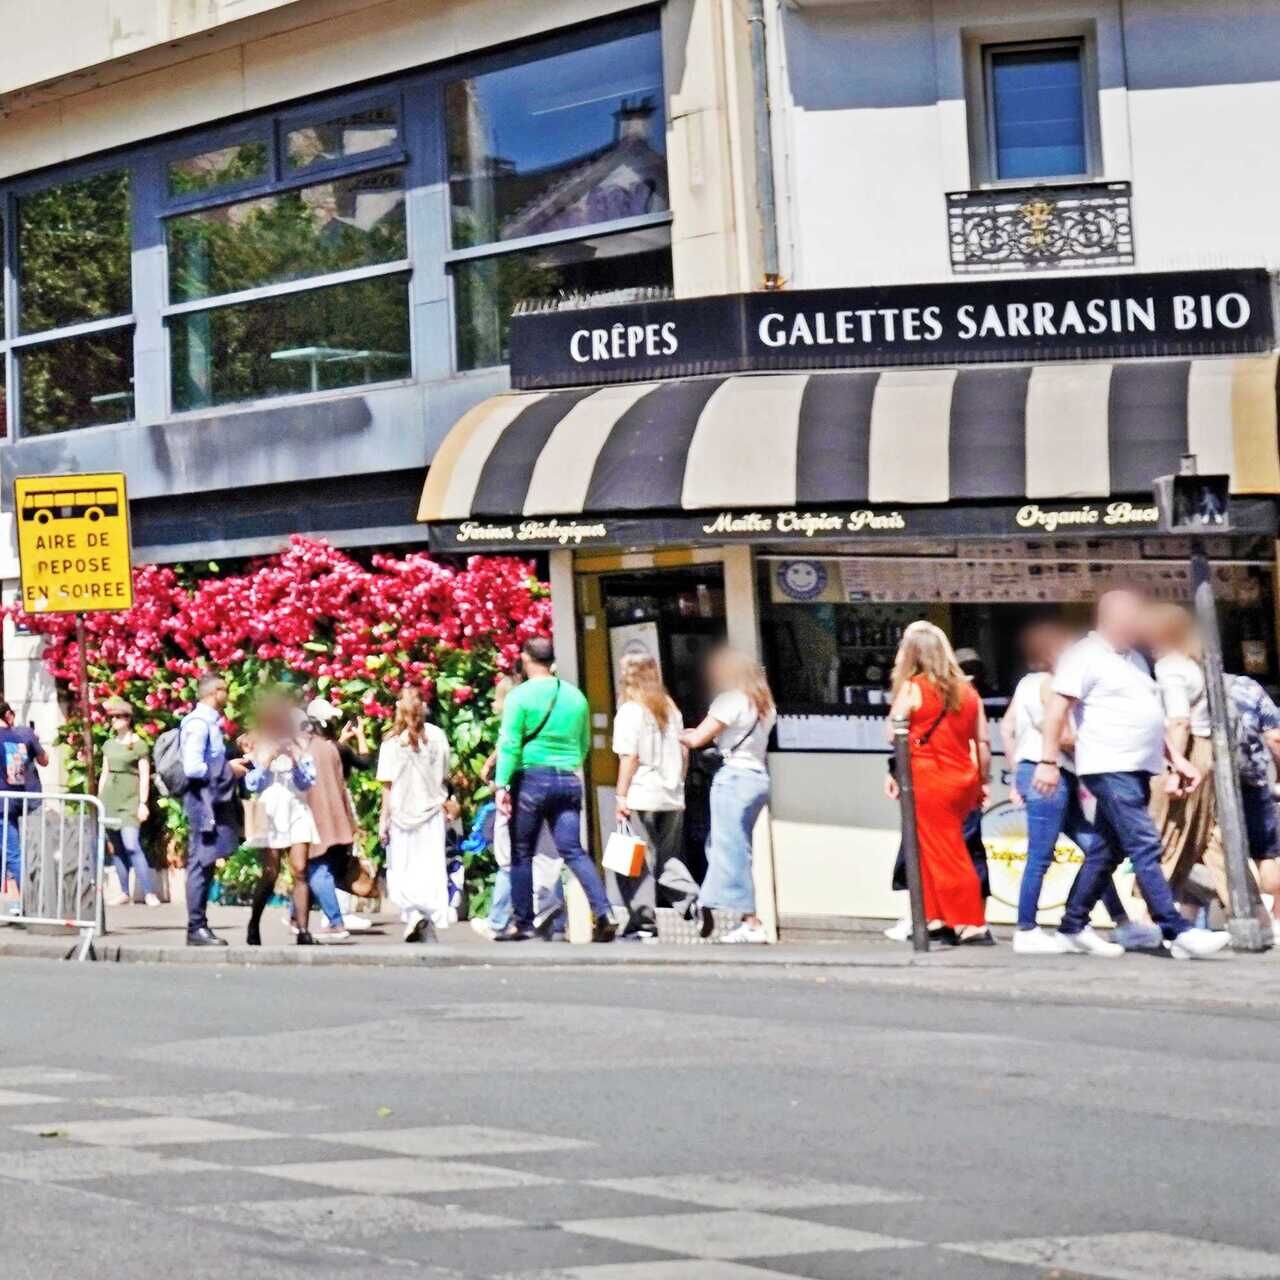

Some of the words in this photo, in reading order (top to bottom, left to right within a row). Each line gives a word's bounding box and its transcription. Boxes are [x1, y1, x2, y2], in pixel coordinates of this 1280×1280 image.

[758, 306, 943, 348] GALETTES
[956, 296, 1157, 340] SARRASIN
[1172, 292, 1252, 331] BIO
[570, 322, 679, 363] CRÊPES
[846, 509, 906, 532] Paris
[1016, 504, 1100, 532] Organic
[35, 533, 77, 550] AIRE
[87, 531, 110, 548] DE
[26, 584, 49, 601] EN
[59, 581, 126, 599] SOIREE
